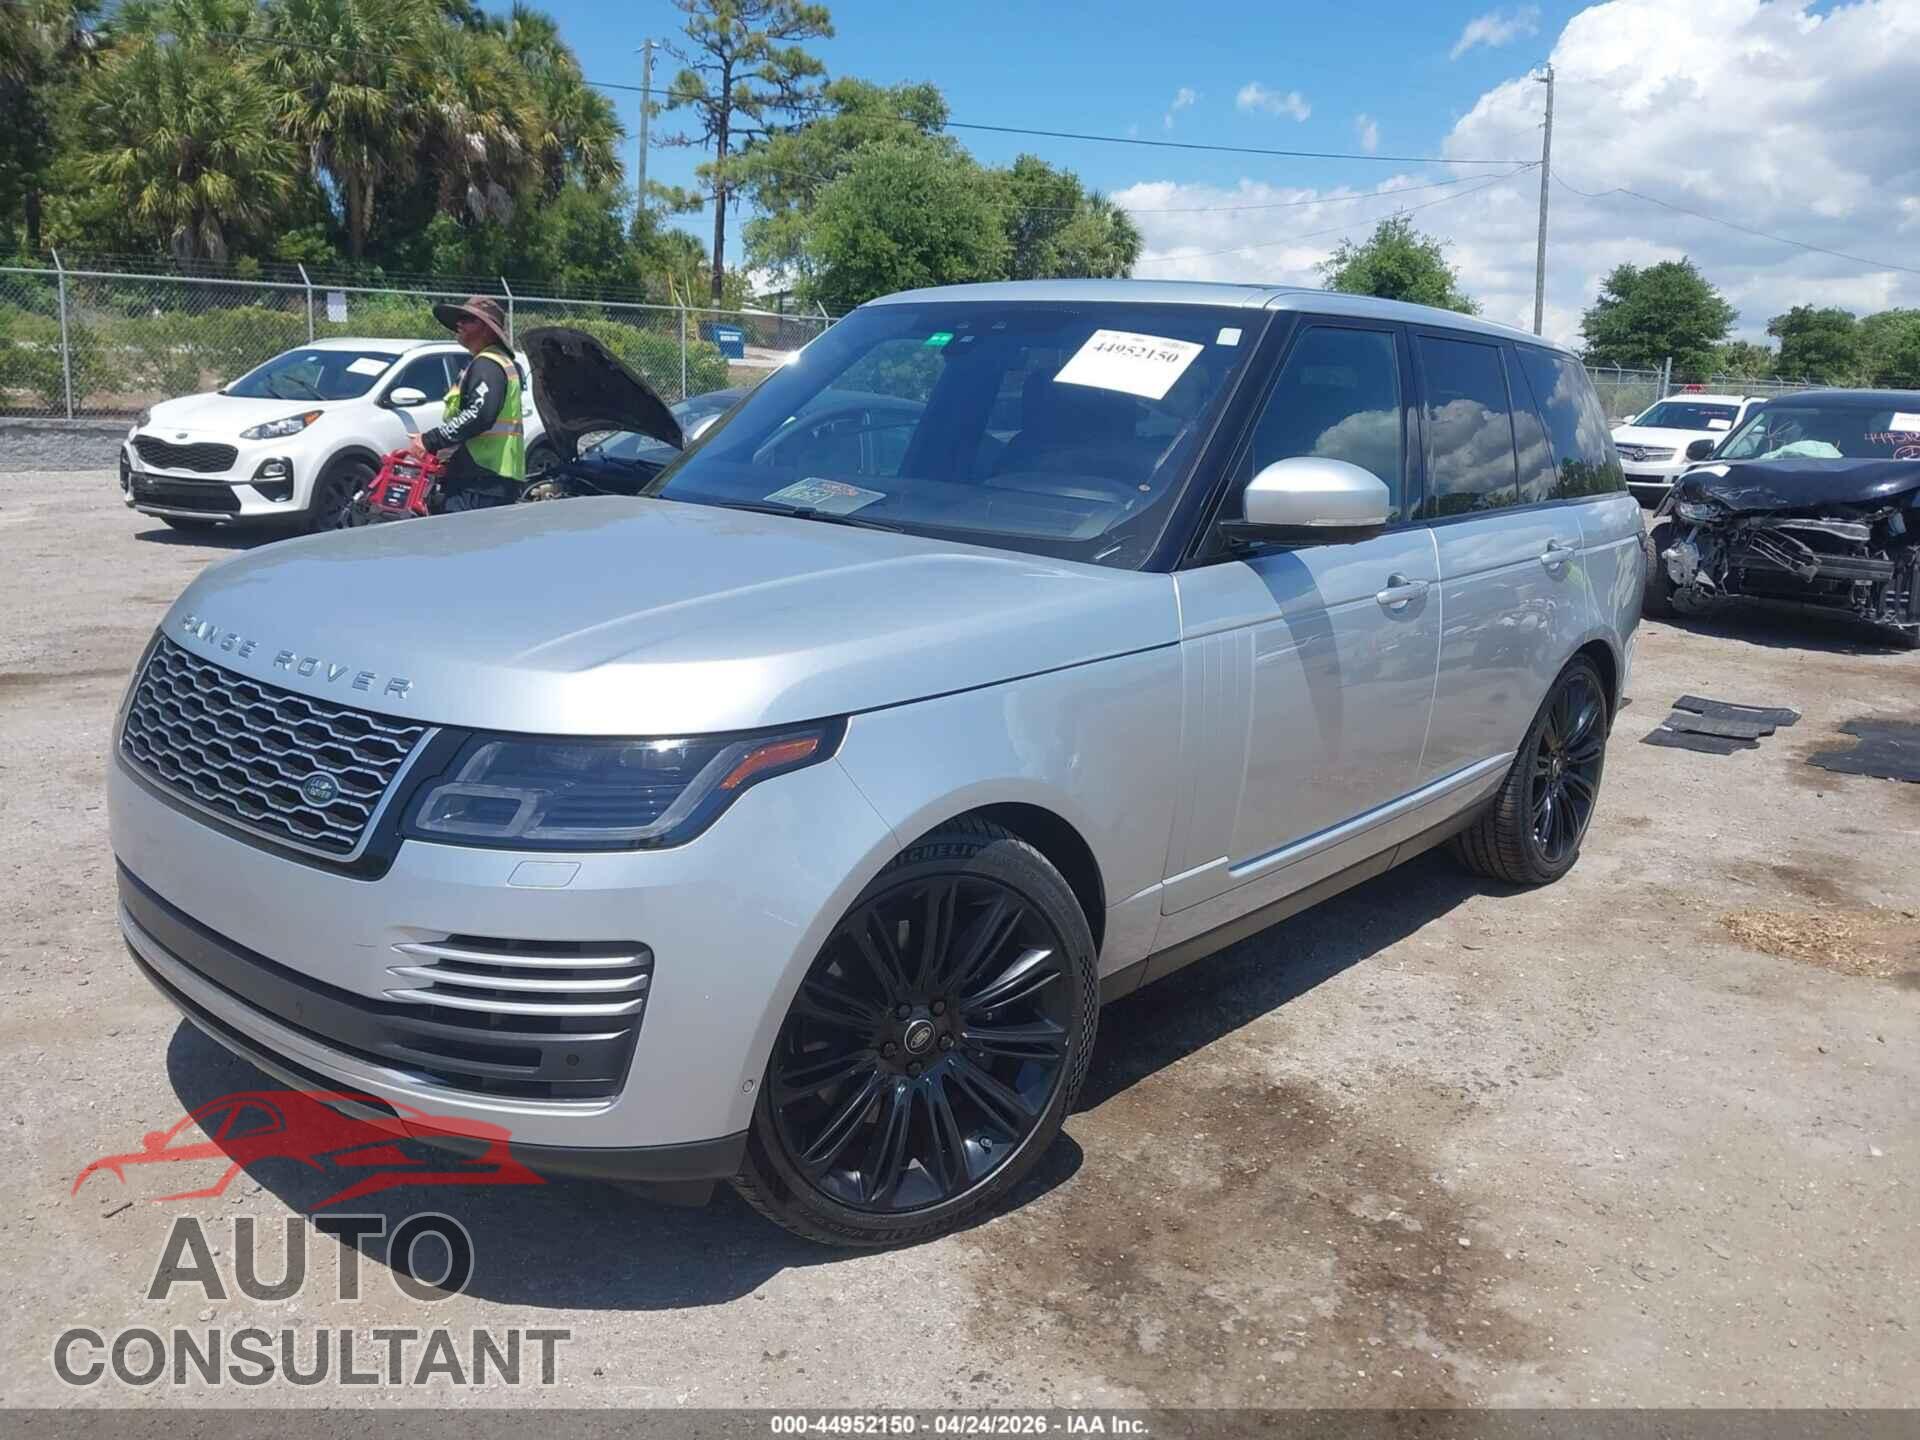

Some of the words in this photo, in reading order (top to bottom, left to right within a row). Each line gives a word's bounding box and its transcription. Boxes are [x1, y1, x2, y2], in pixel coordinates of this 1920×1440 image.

[1093, 341, 1180, 363] 44952150
[183, 614, 259, 659] RANGE
[273, 649, 414, 699] ROVER
[894, 842, 980, 866] ICHELIN
